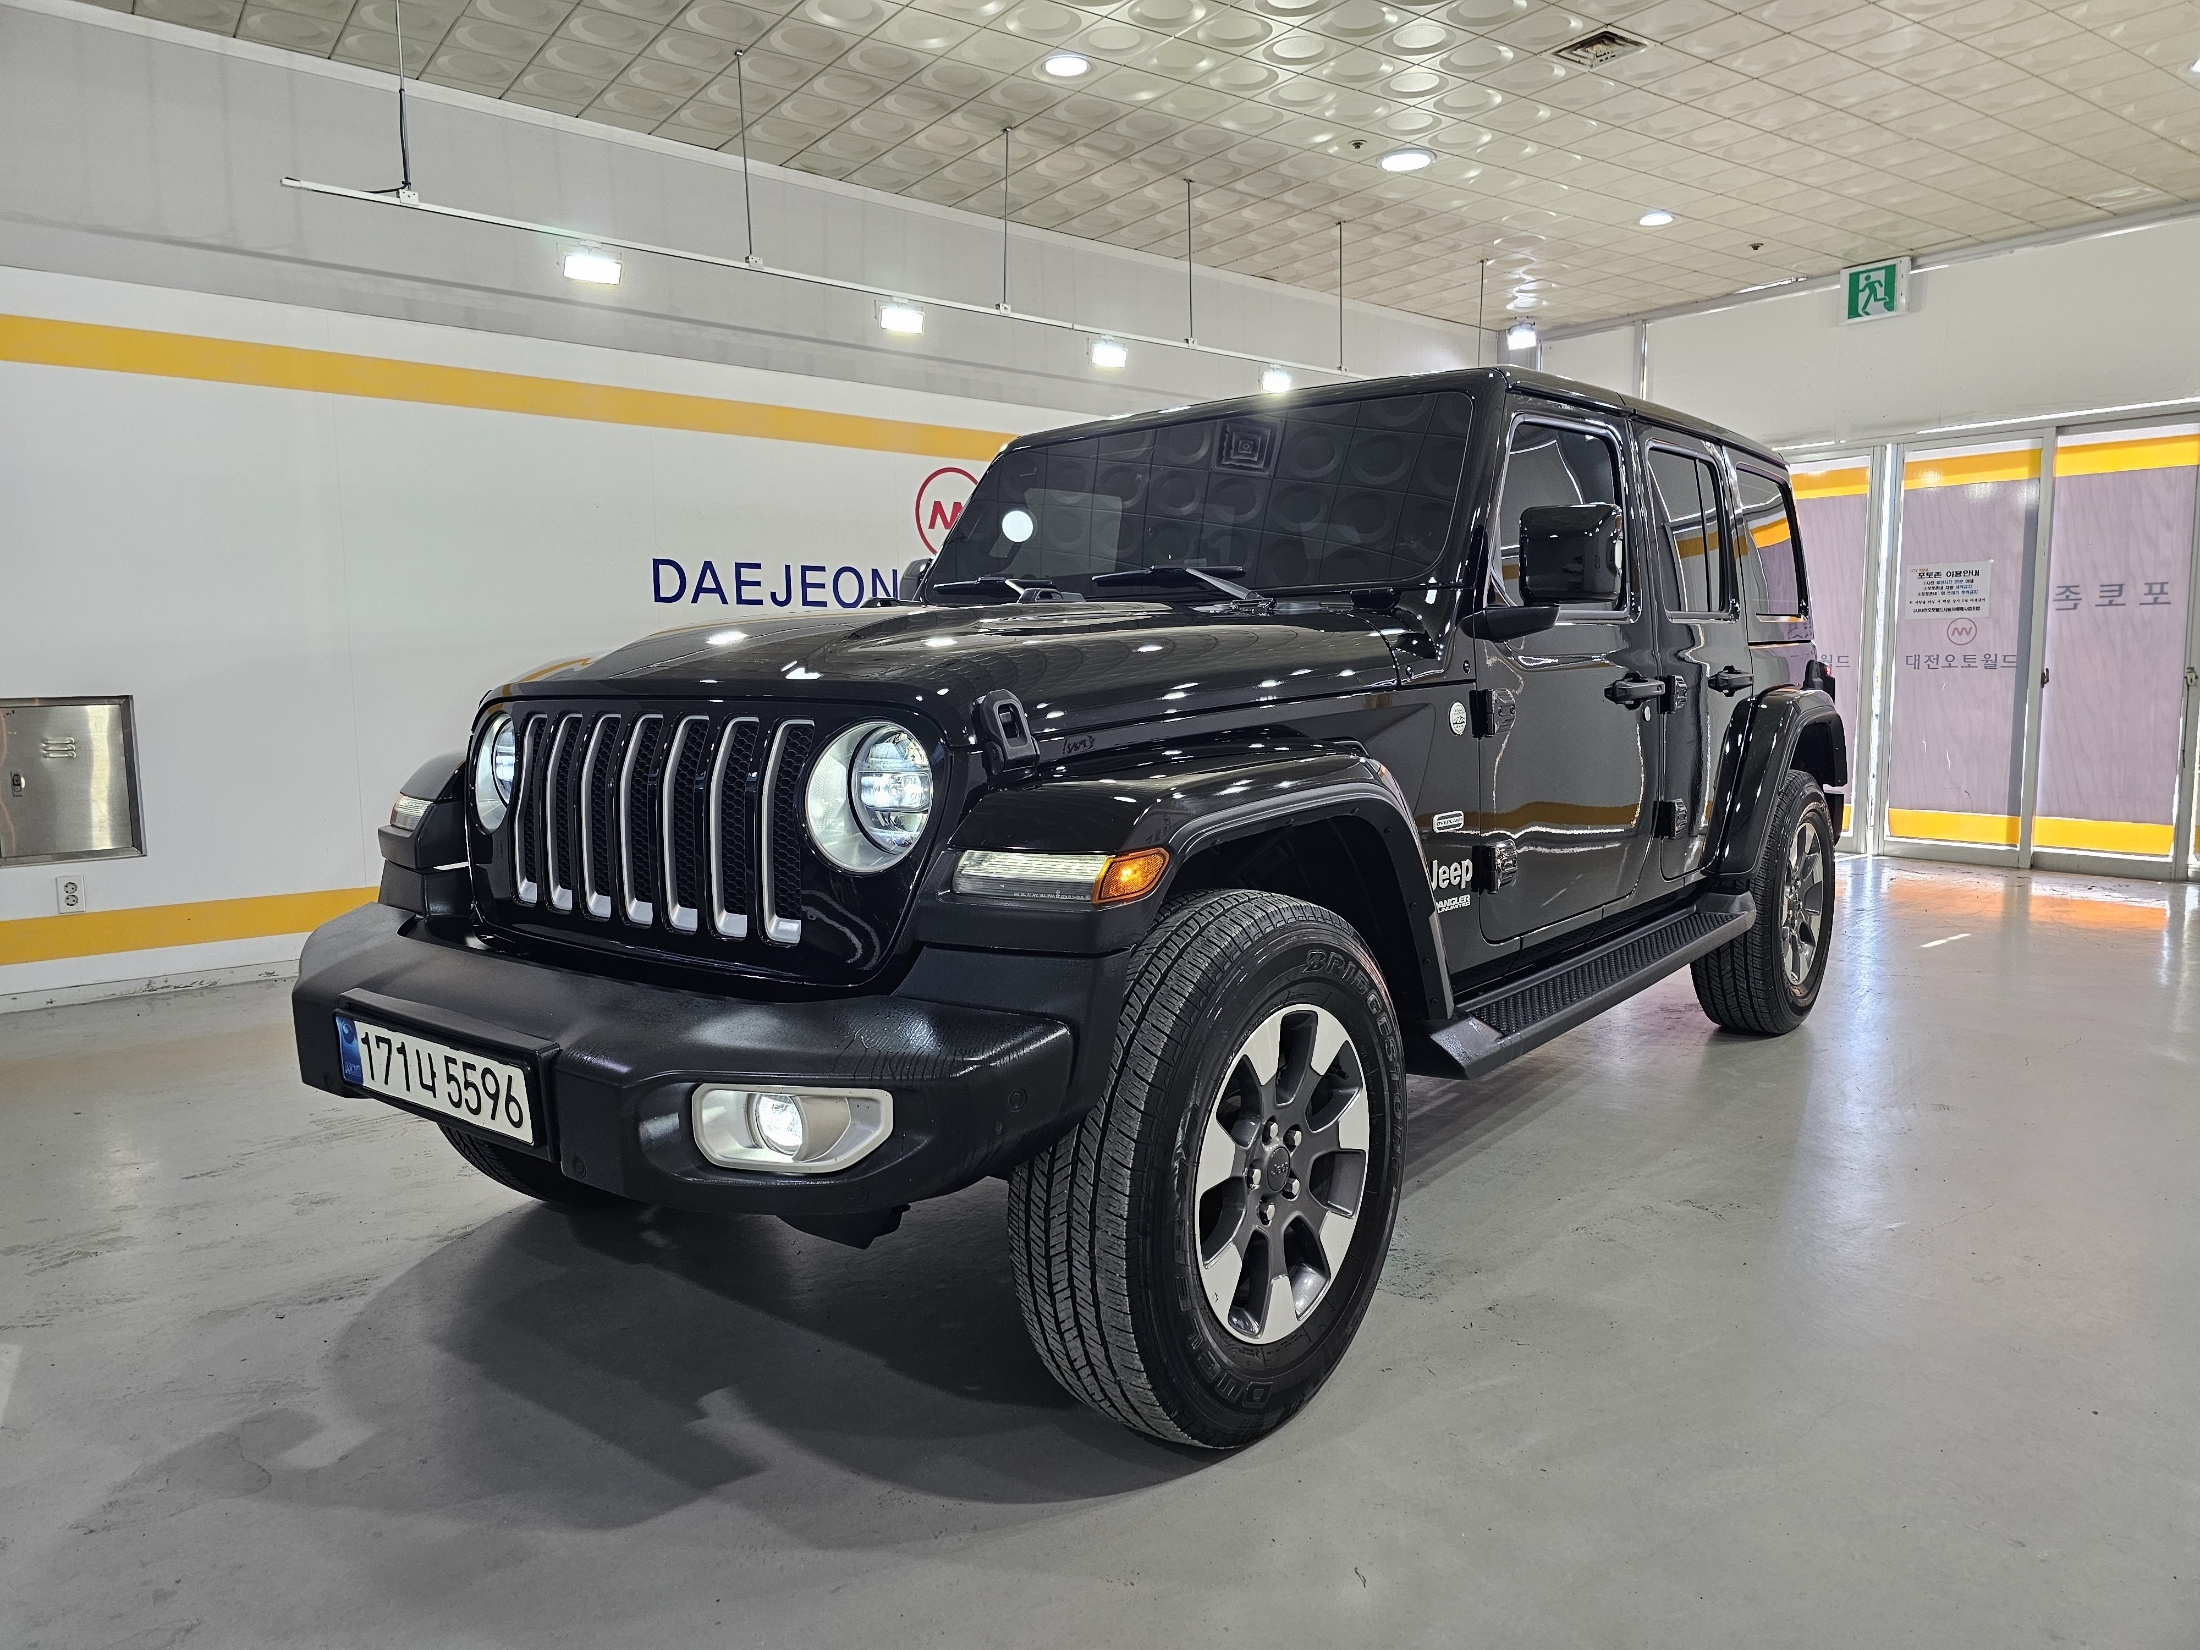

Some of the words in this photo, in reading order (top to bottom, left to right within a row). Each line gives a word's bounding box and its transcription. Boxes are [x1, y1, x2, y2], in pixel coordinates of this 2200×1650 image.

[652, 558, 898, 609] DAEJEON
[1946, 570, 1980, 578] 이용안내
[1905, 653, 2018, 670] 대전오토월드
[1430, 858, 1473, 890] Jeep
[361, 1031, 437, 1099] 171나
[443, 1054, 523, 1129] 5596
